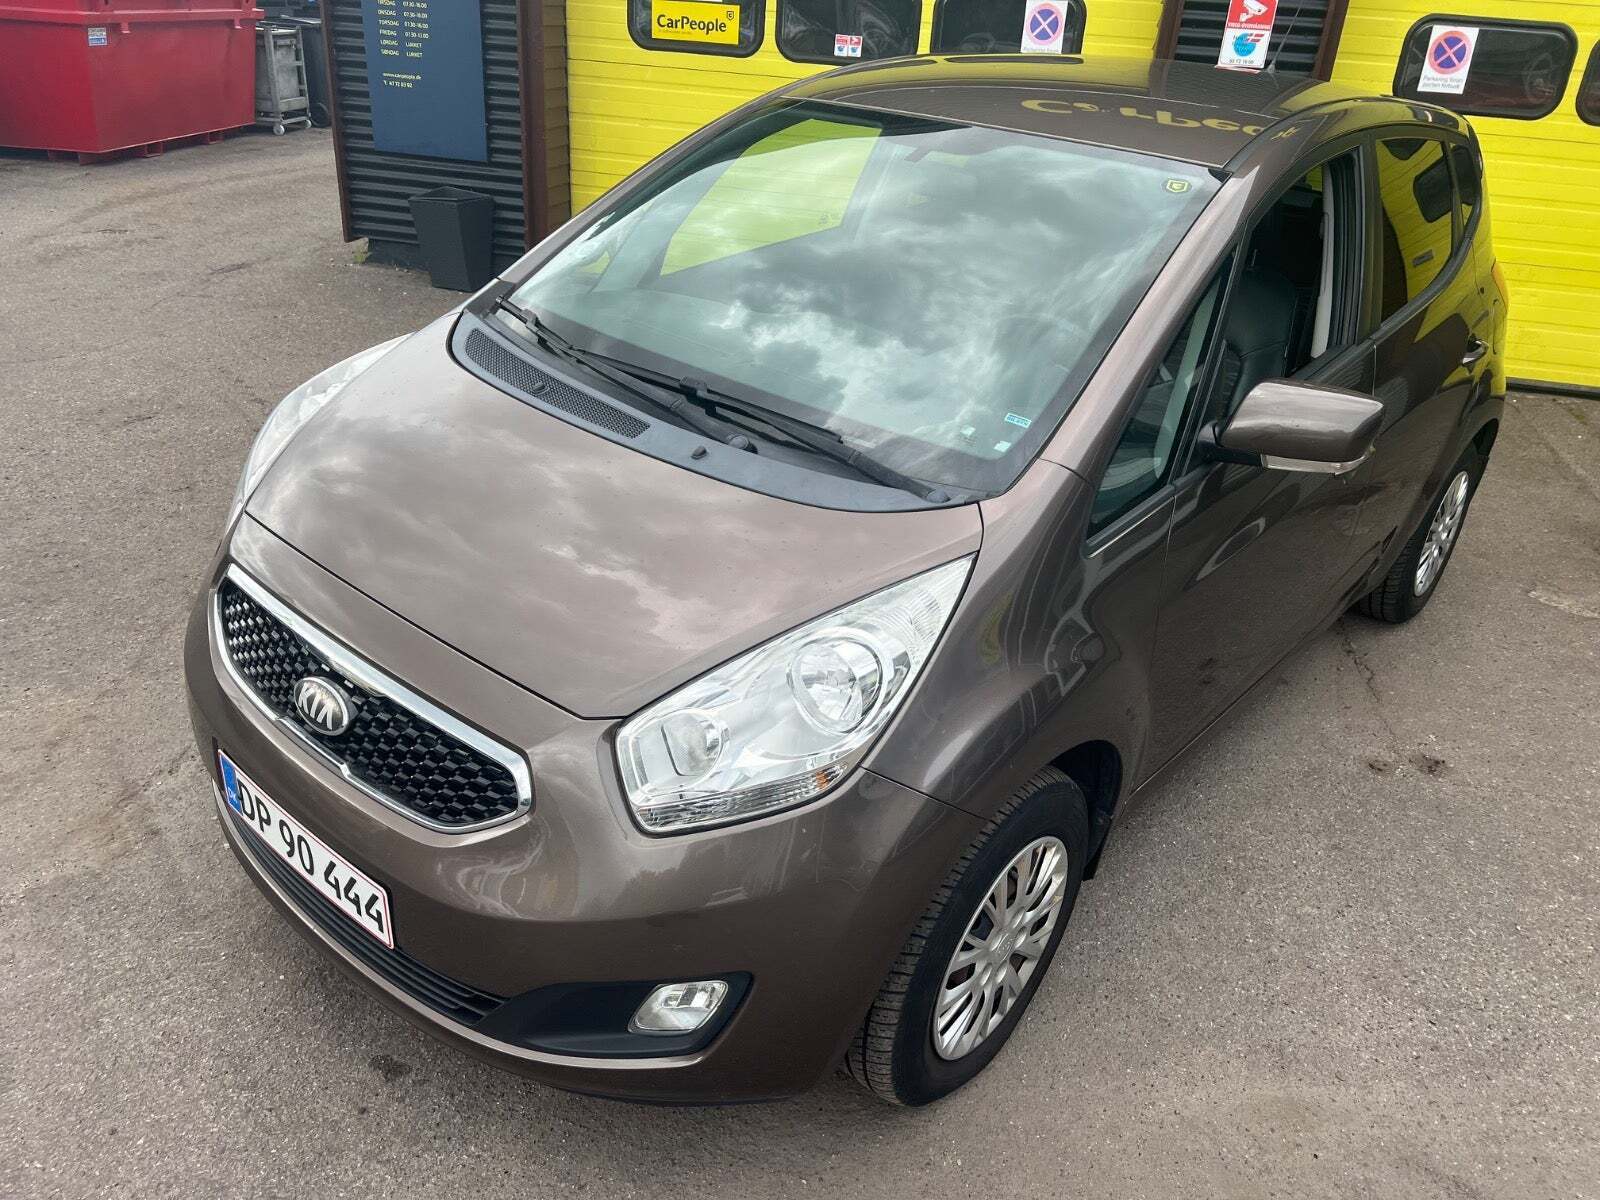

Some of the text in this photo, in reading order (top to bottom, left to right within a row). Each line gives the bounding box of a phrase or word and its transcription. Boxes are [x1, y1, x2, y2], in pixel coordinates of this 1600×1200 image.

[657, 14, 727, 35] CarPeople
[299, 682, 334, 731] KIA
[238, 781, 385, 934] DP 90 444
